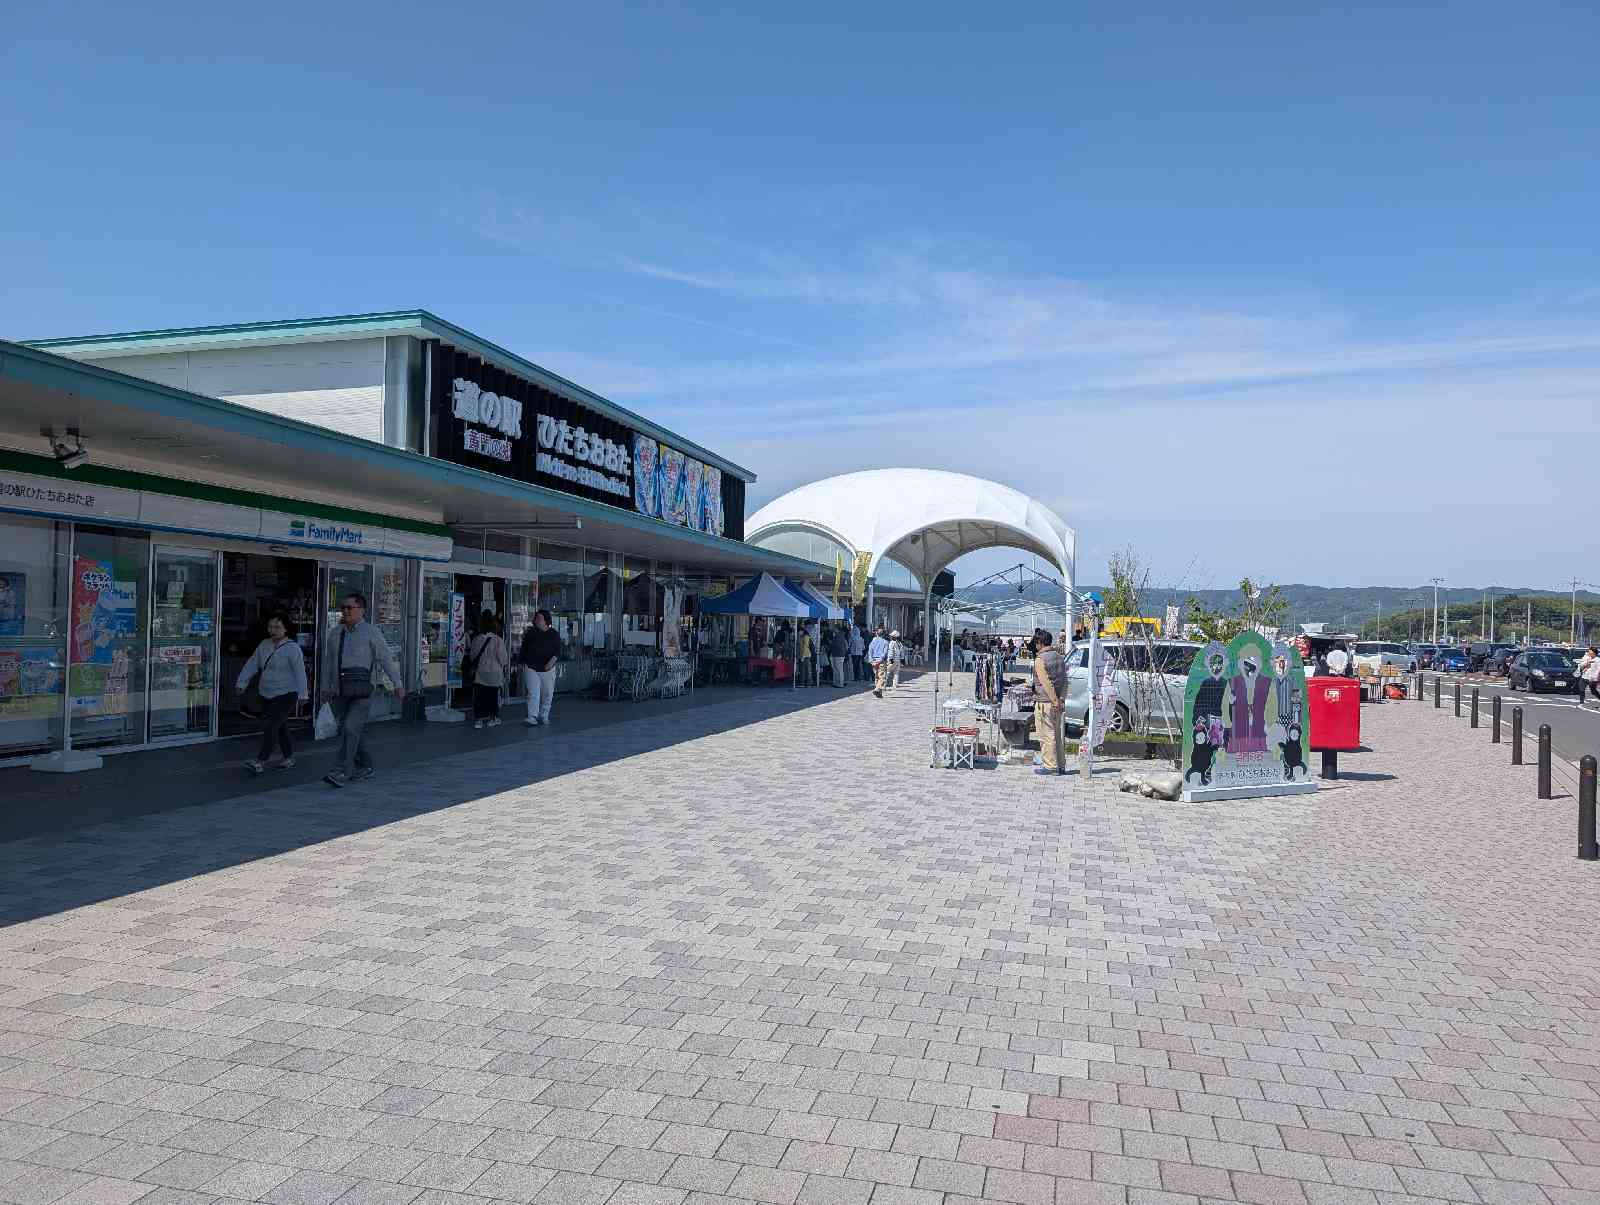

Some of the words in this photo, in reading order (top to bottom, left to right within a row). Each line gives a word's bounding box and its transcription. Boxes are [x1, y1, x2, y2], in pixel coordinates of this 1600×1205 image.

[452, 377, 522, 440] 道の駅
[537, 413, 632, 477] ひたちおおた
